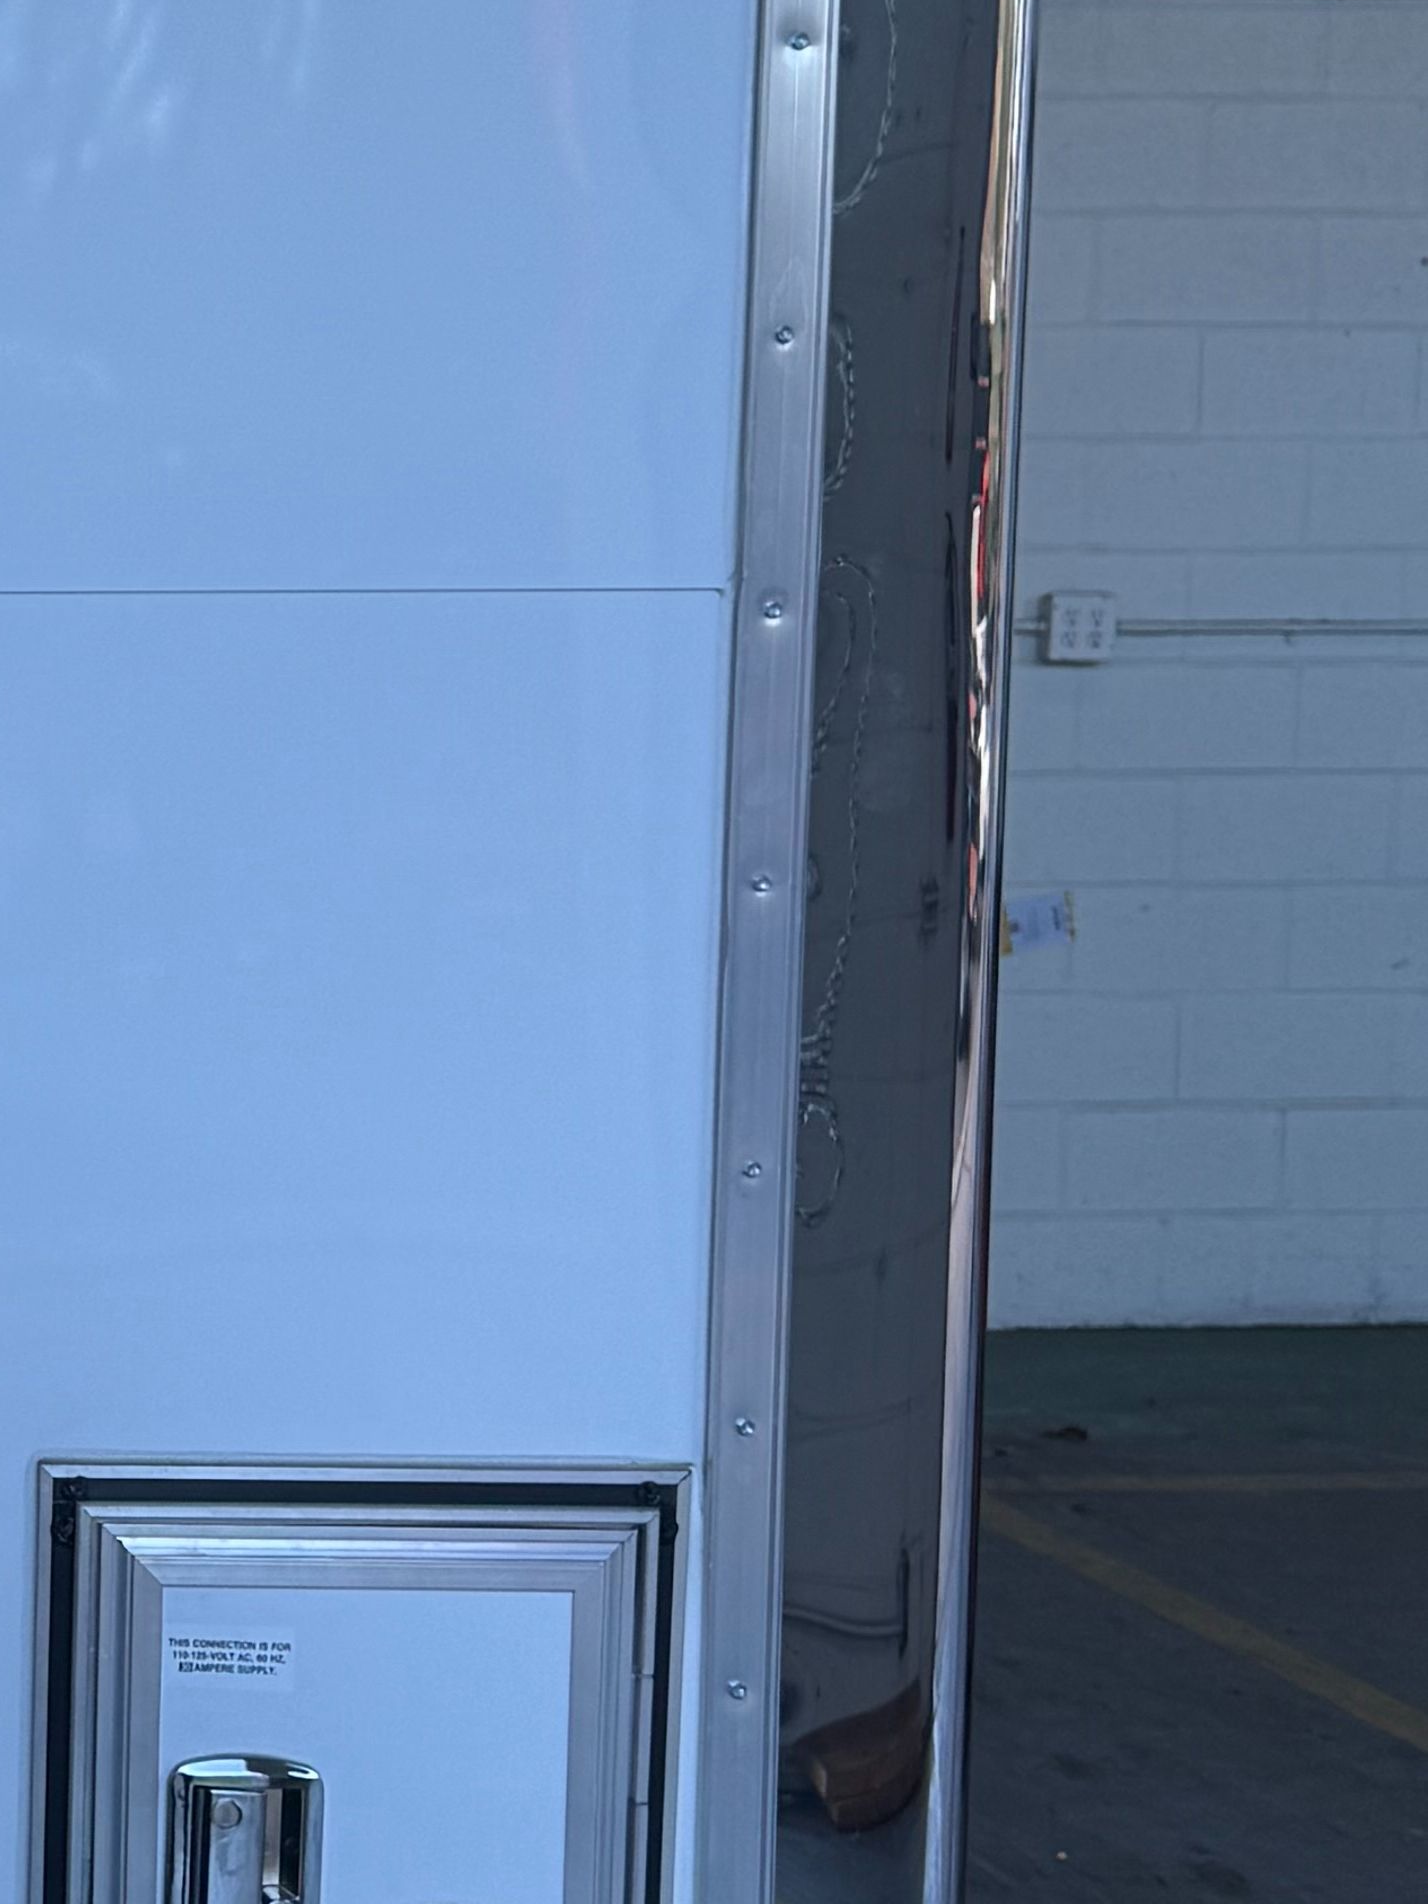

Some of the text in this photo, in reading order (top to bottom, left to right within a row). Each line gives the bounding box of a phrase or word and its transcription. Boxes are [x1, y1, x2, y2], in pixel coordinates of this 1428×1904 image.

[168, 1638, 291, 1652] THIS CONNECTION IS FOR
